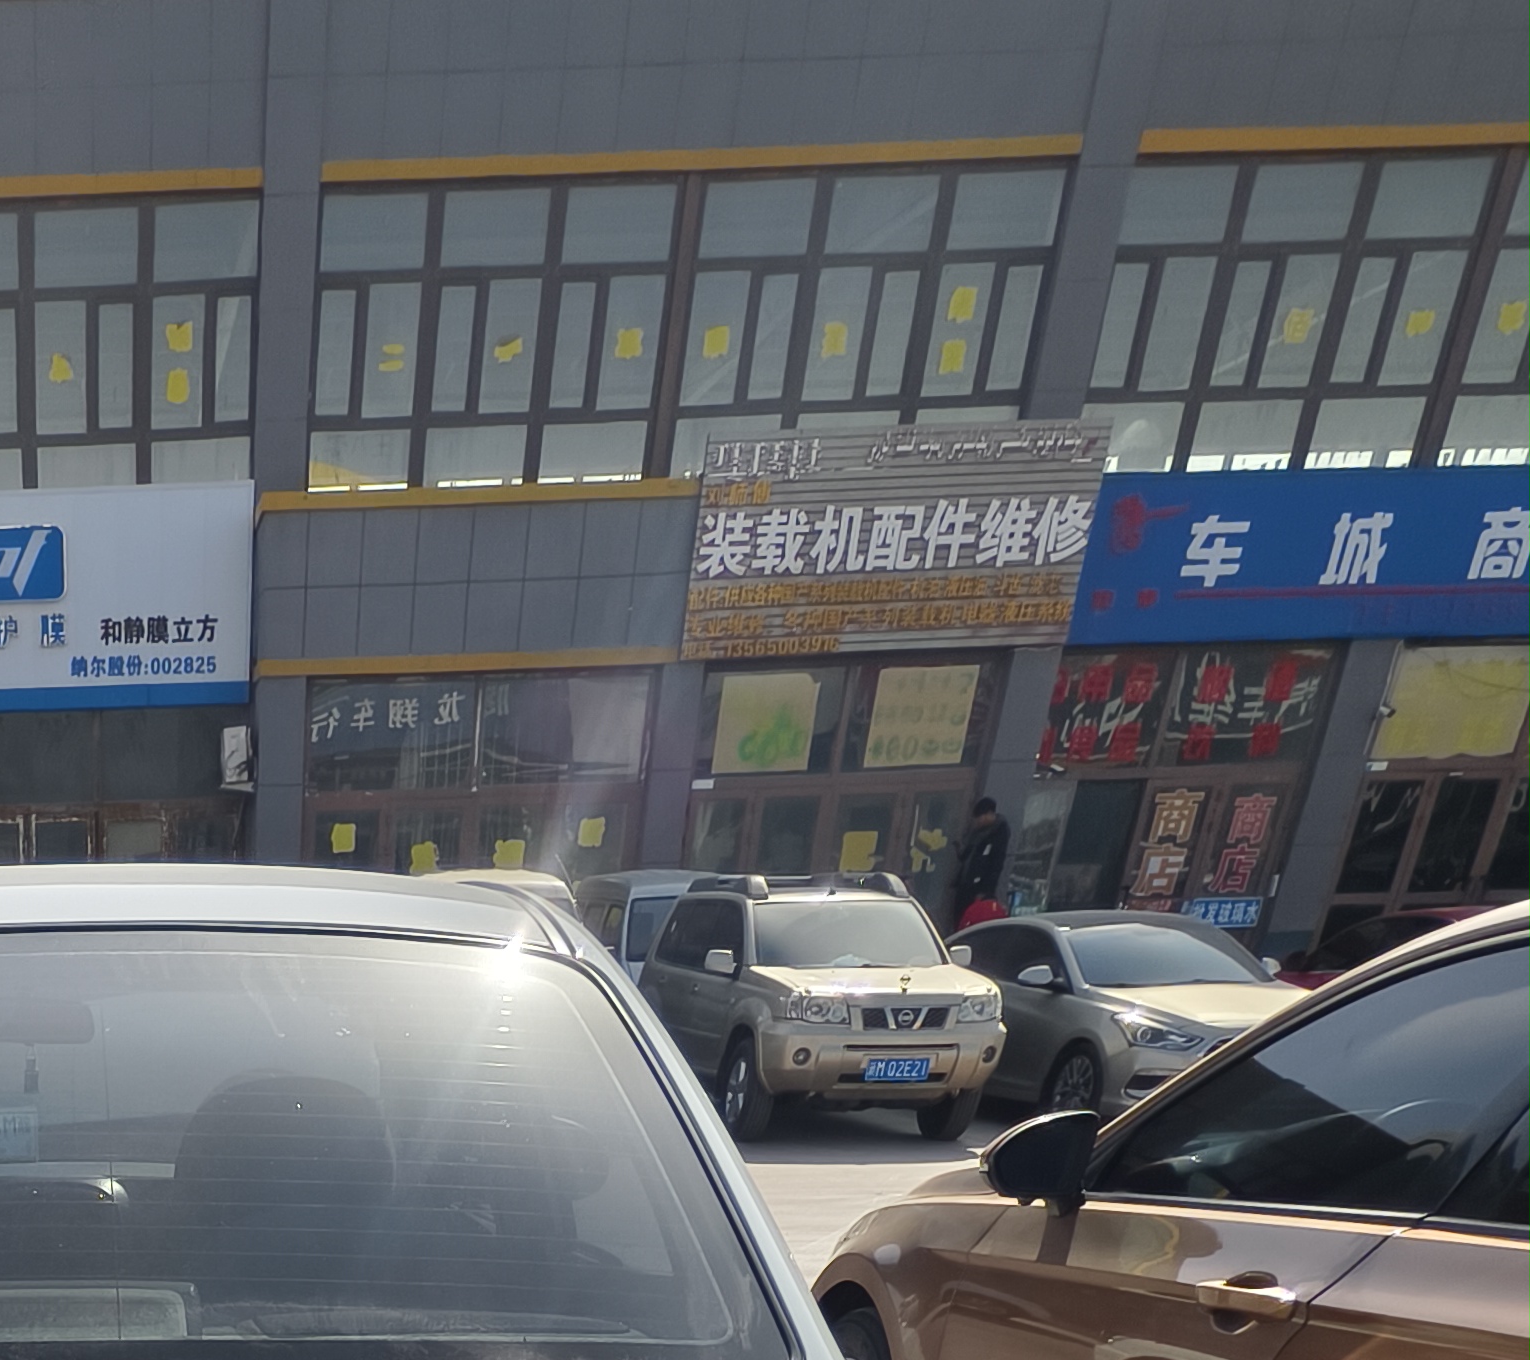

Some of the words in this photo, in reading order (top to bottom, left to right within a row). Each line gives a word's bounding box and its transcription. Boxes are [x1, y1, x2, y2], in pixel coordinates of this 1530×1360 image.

[696, 494, 1093, 579] 装载机配件维修
[71, 655, 216, 677] 纳尔股份:002825
[100, 614, 218, 645] 和静膜立方
[1130, 788, 1205, 896] 商店
[1207, 793, 1277, 893] 商店
